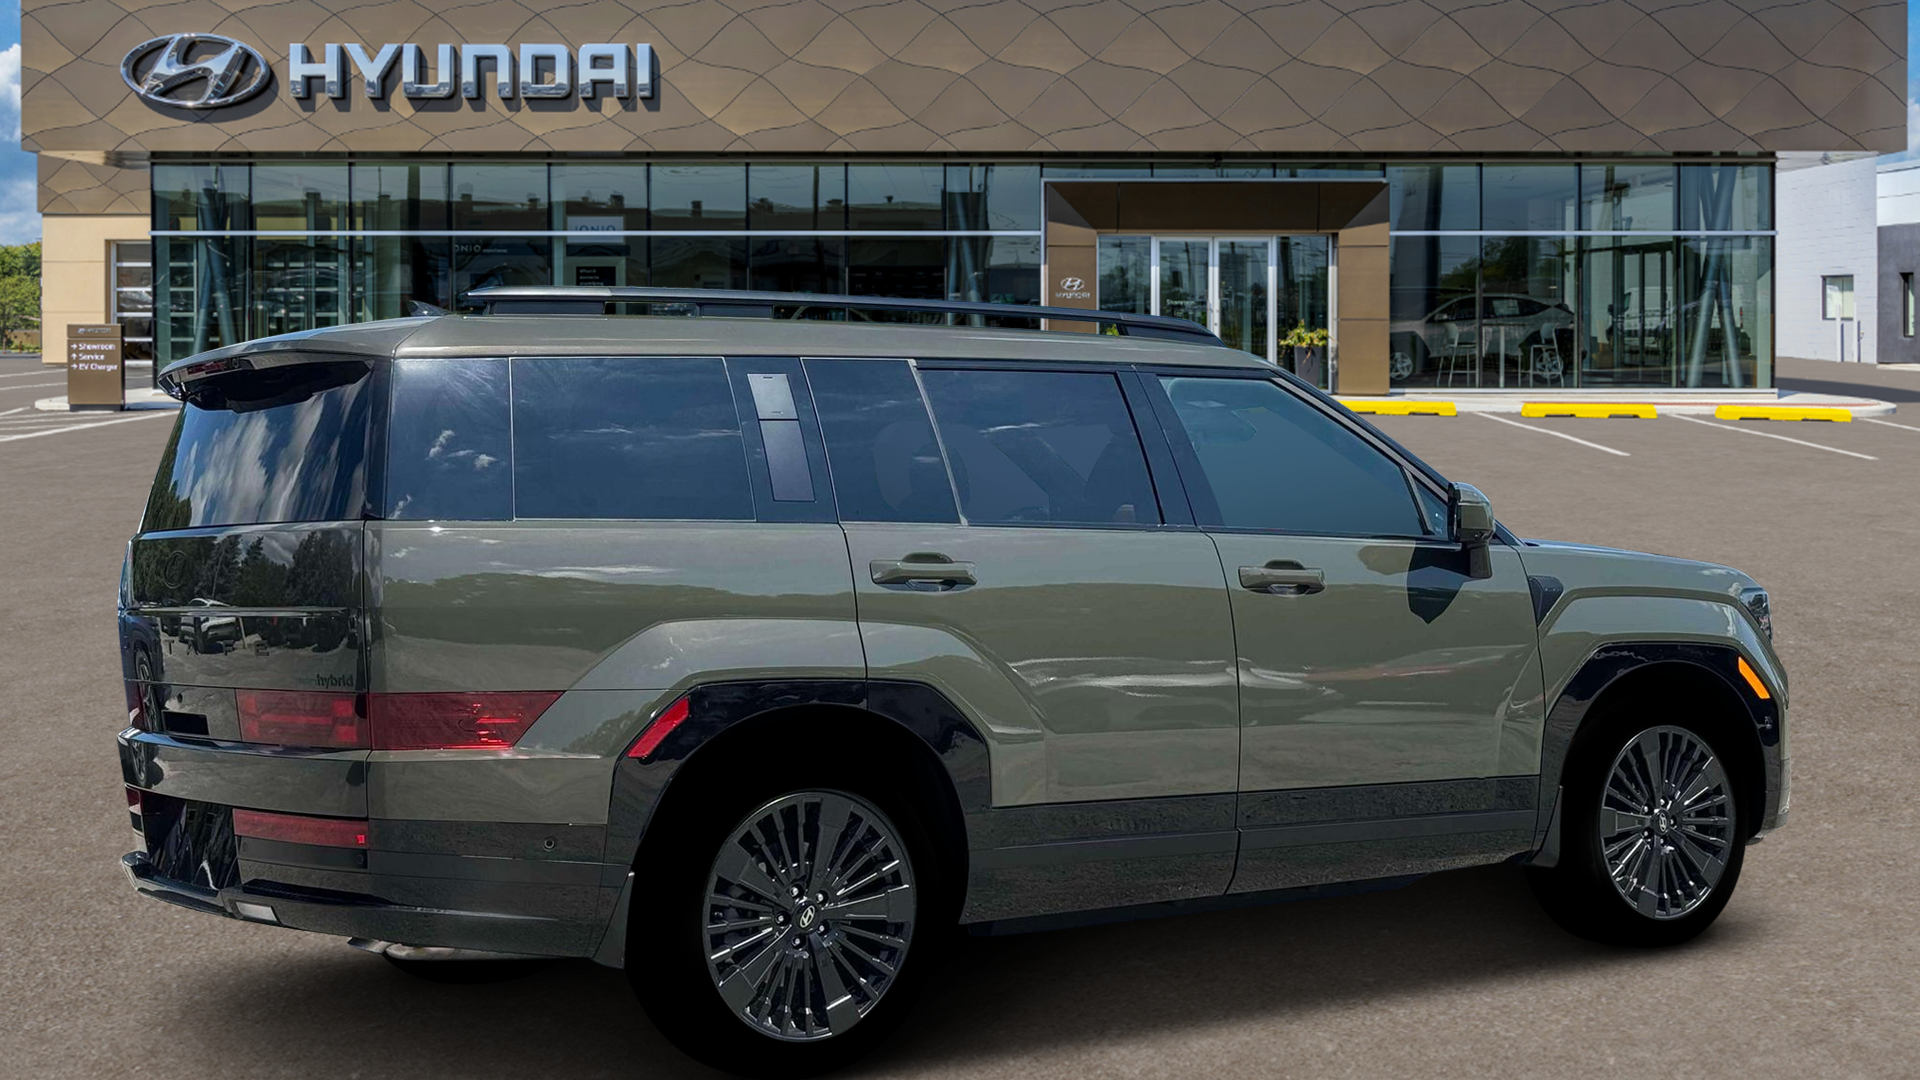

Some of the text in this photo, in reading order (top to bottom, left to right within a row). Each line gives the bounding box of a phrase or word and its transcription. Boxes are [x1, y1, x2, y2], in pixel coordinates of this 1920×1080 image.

[289, 43, 656, 99] HYUNDAI
[78, 342, 116, 350] Showroom
[78, 352, 105, 361] Service
[90, 363, 118, 372] Charger
[316, 674, 354, 688] hybrid
